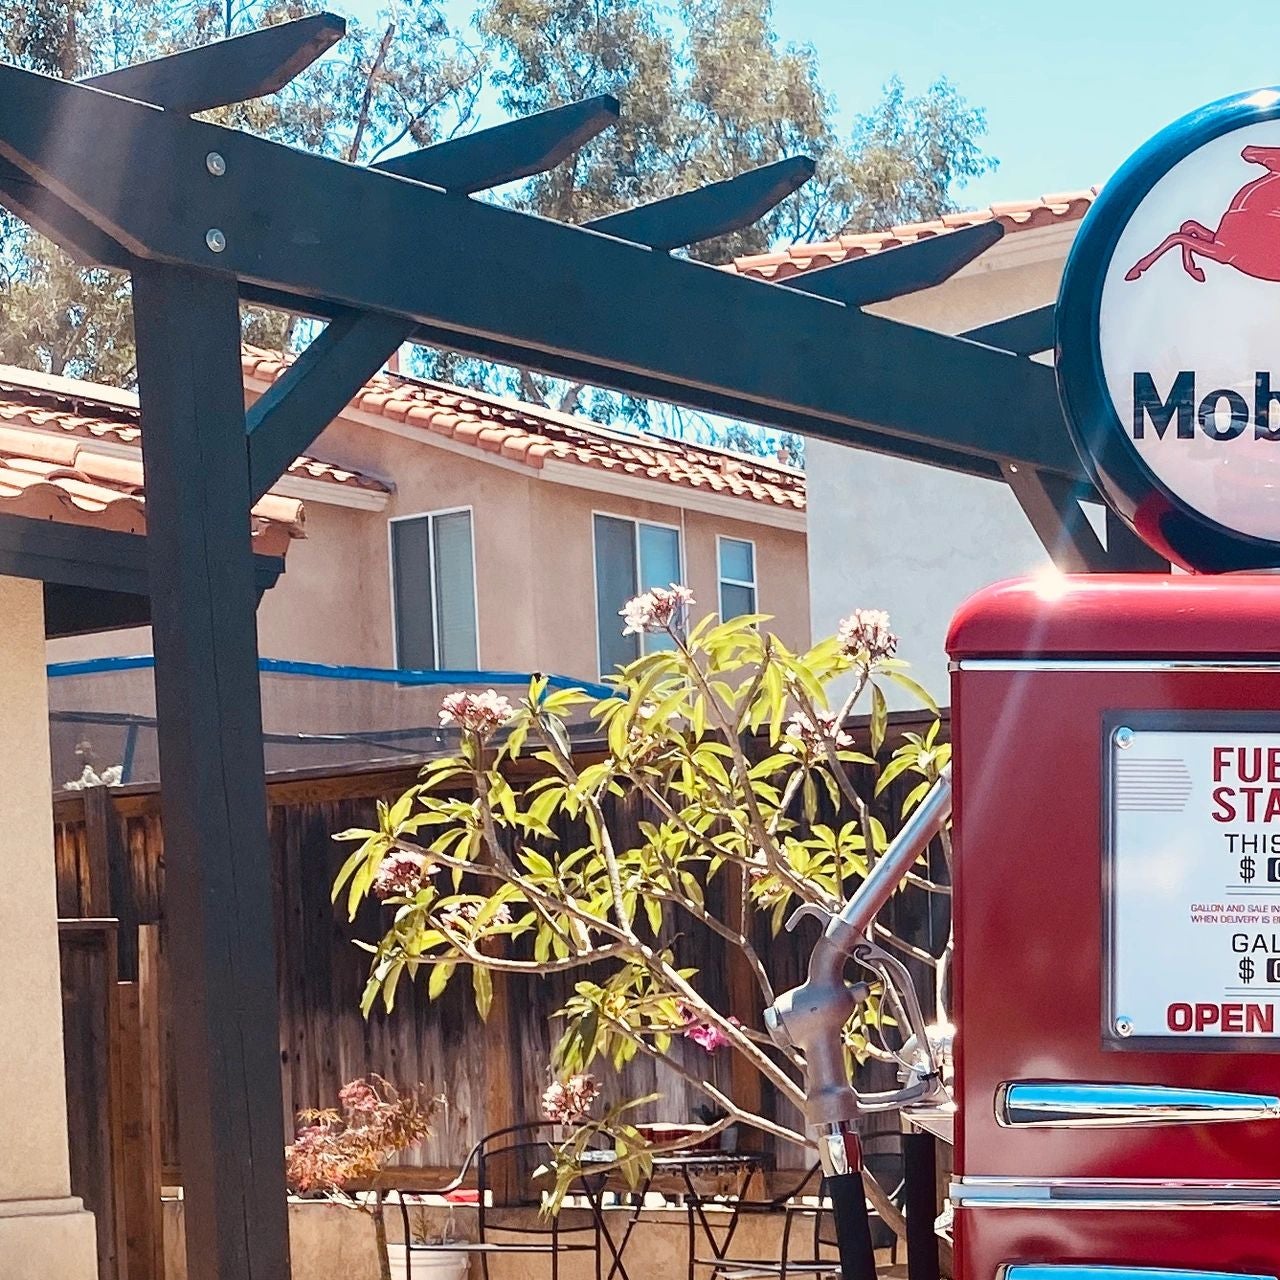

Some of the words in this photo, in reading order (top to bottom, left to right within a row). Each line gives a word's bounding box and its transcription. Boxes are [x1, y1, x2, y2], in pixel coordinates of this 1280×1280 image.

[1239, 856, 1256, 883] $
[1190, 903, 1224, 913] GALLON
[1226, 904, 1246, 913] AND
[1247, 904, 1269, 913] SALE
[1190, 915, 1218, 924] WHEN
[1220, 915, 1260, 924] DELIVERY
[1261, 915, 1271, 924] IS
[1238, 956, 1256, 984] $
[1166, 1002, 1275, 1033] OPEN
